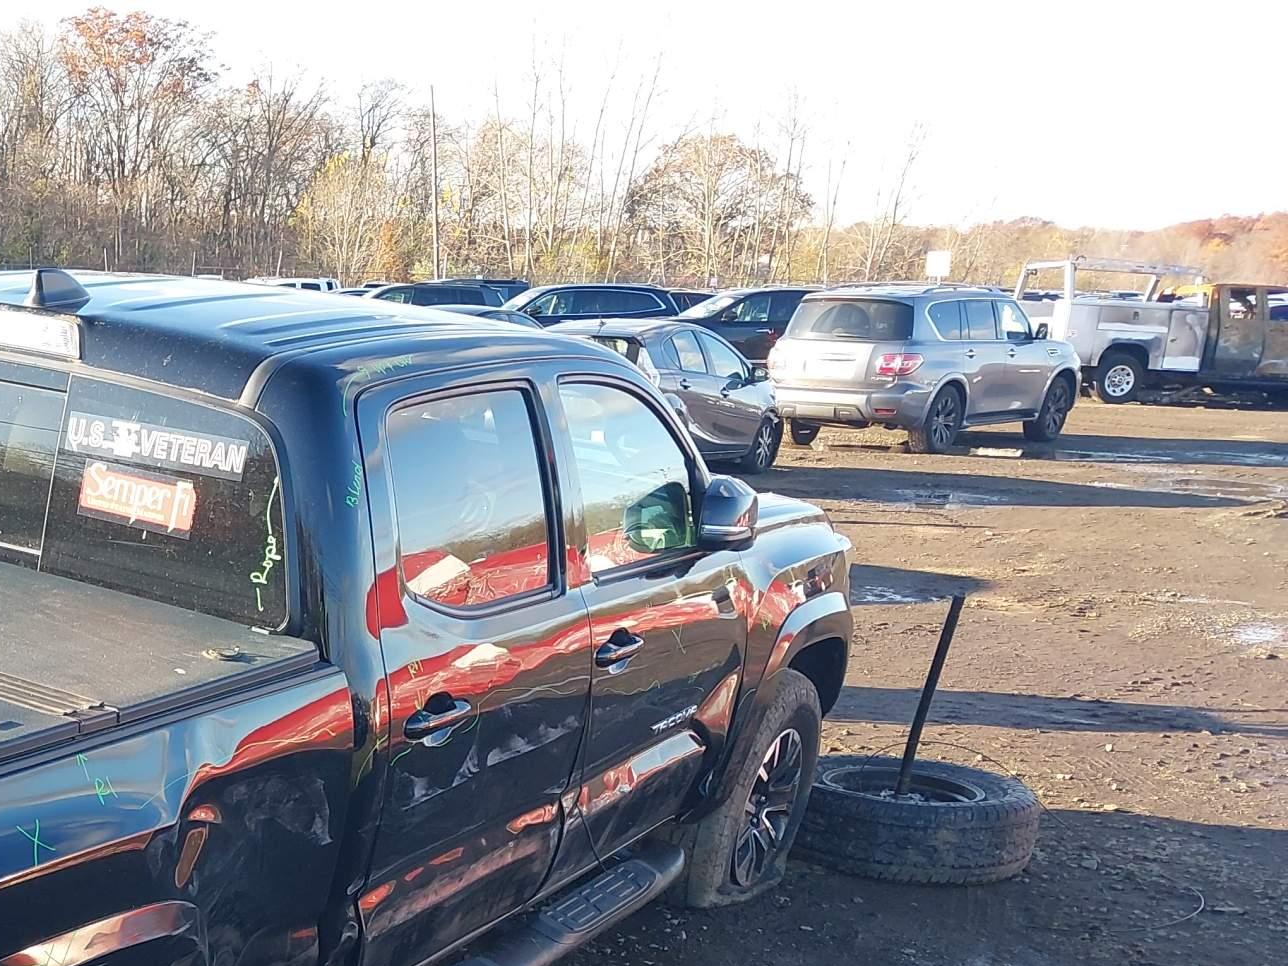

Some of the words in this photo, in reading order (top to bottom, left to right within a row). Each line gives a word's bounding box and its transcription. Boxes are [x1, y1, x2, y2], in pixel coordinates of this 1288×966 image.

[140, 429, 247, 474] VETERAN
[86, 462, 171, 525] Semper
[650, 704, 698, 735] TACOMA
